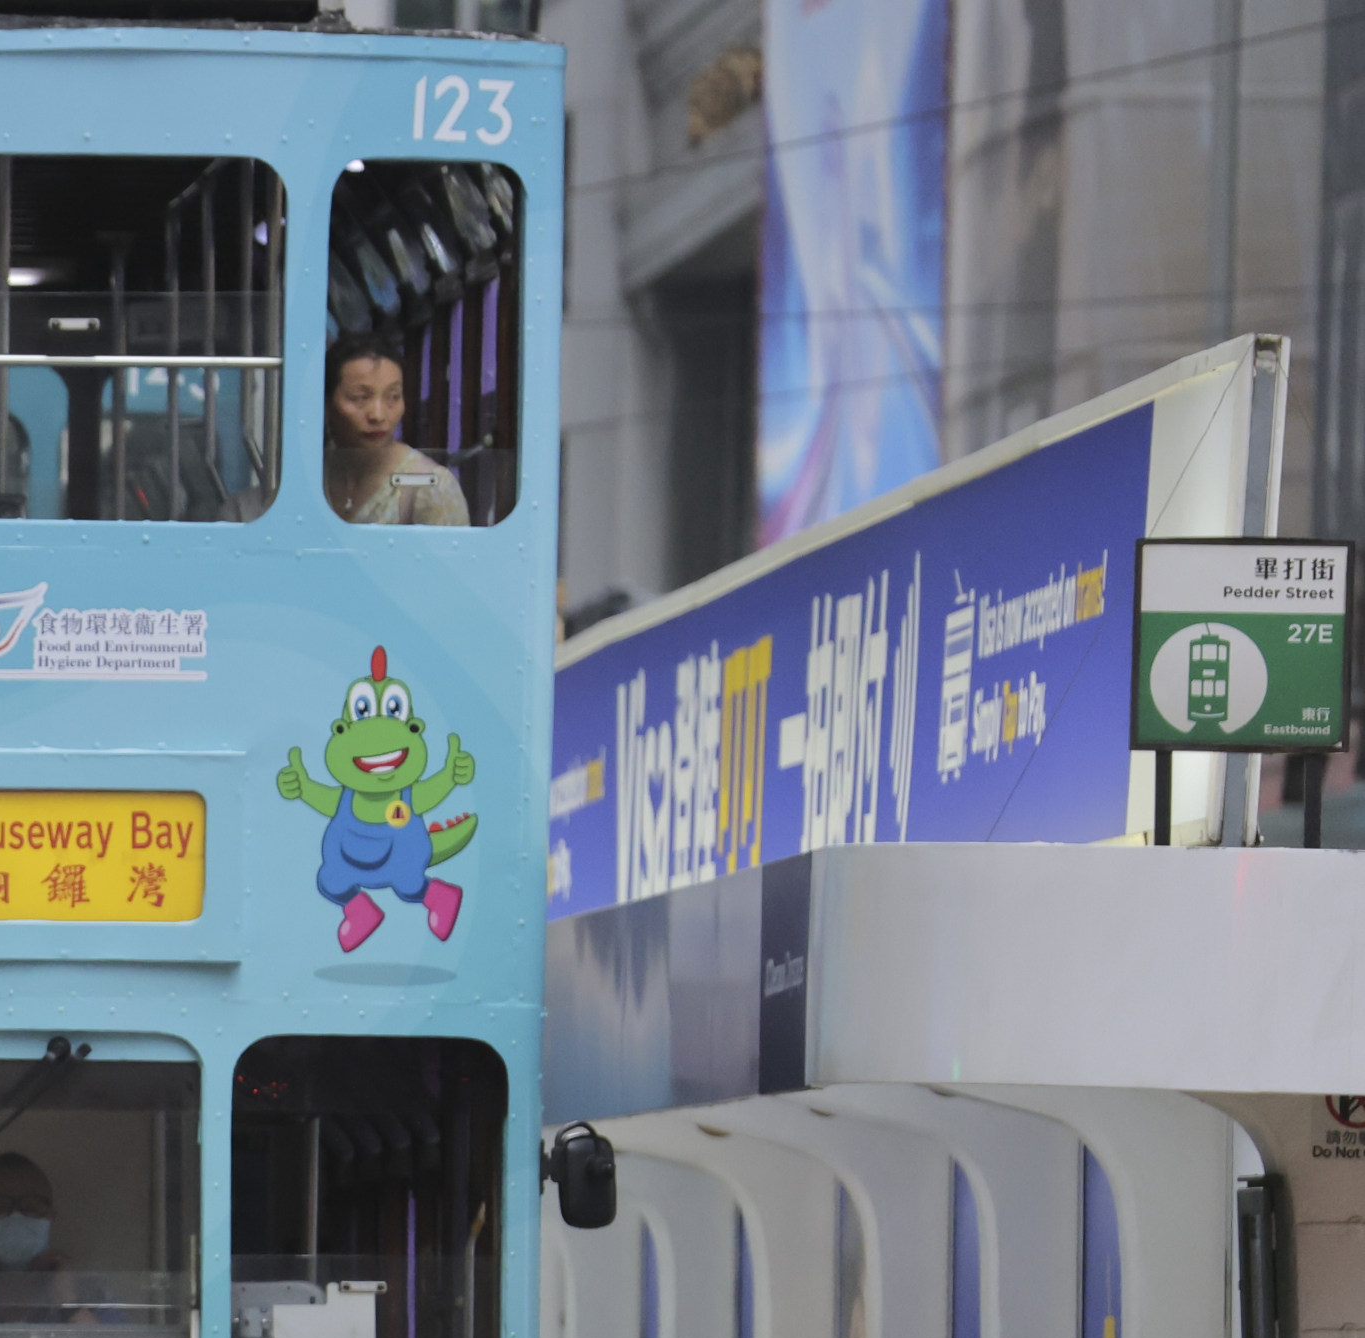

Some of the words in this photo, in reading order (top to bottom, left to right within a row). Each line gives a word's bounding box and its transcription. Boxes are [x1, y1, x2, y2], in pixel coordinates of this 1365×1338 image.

[412, 75, 514, 146] 123
[1255, 557, 1335, 581] 畢打街
[1223, 586, 1280, 599] Pedder
[1286, 586, 1335, 600] Street
[1287, 624, 1333, 643] 27E
[38, 640, 71, 653] Food
[75, 640, 100, 653] and
[105, 640, 203, 653] Environmental
[38, 656, 92, 670] Hygiene
[97, 656, 176, 671] Department
[1302, 707, 1330, 723] 東行
[1264, 724, 1331, 736] Eastbound
[131, 811, 194, 858] Bay
[1312, 1145, 1332, 1158] Do
[1335, 1146, 1360, 1158] Not
